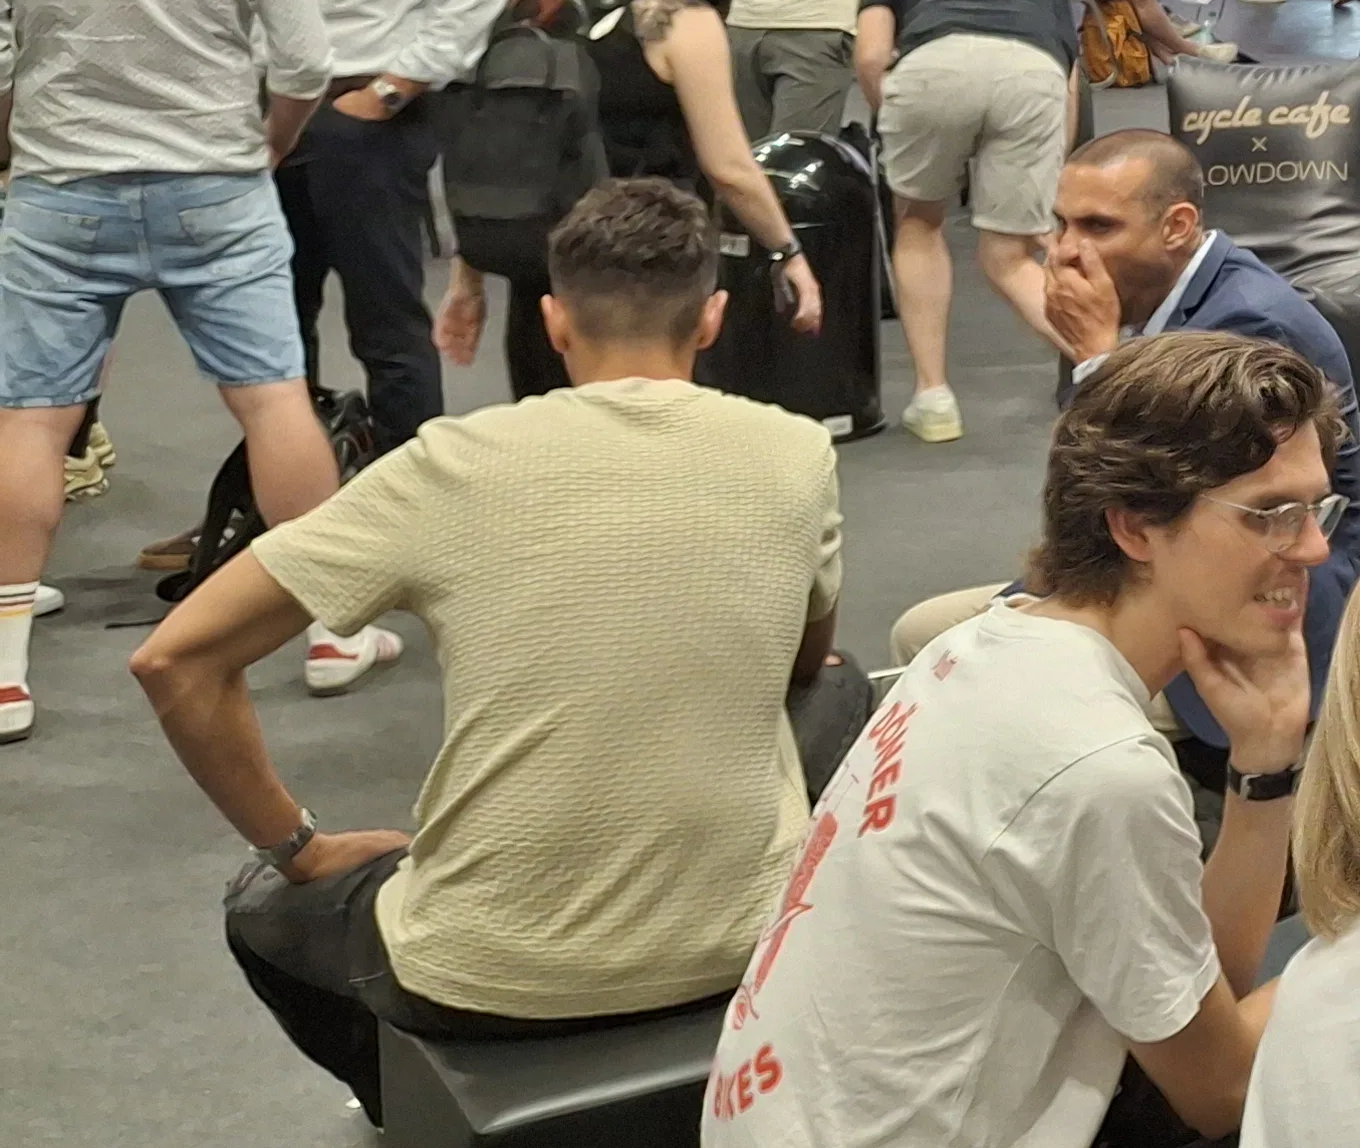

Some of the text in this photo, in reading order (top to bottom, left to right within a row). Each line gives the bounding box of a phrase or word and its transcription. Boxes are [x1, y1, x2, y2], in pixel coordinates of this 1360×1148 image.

[1182, 90, 1350, 145] cycle cafe
[1202, 160, 1348, 188] OWDOWN
